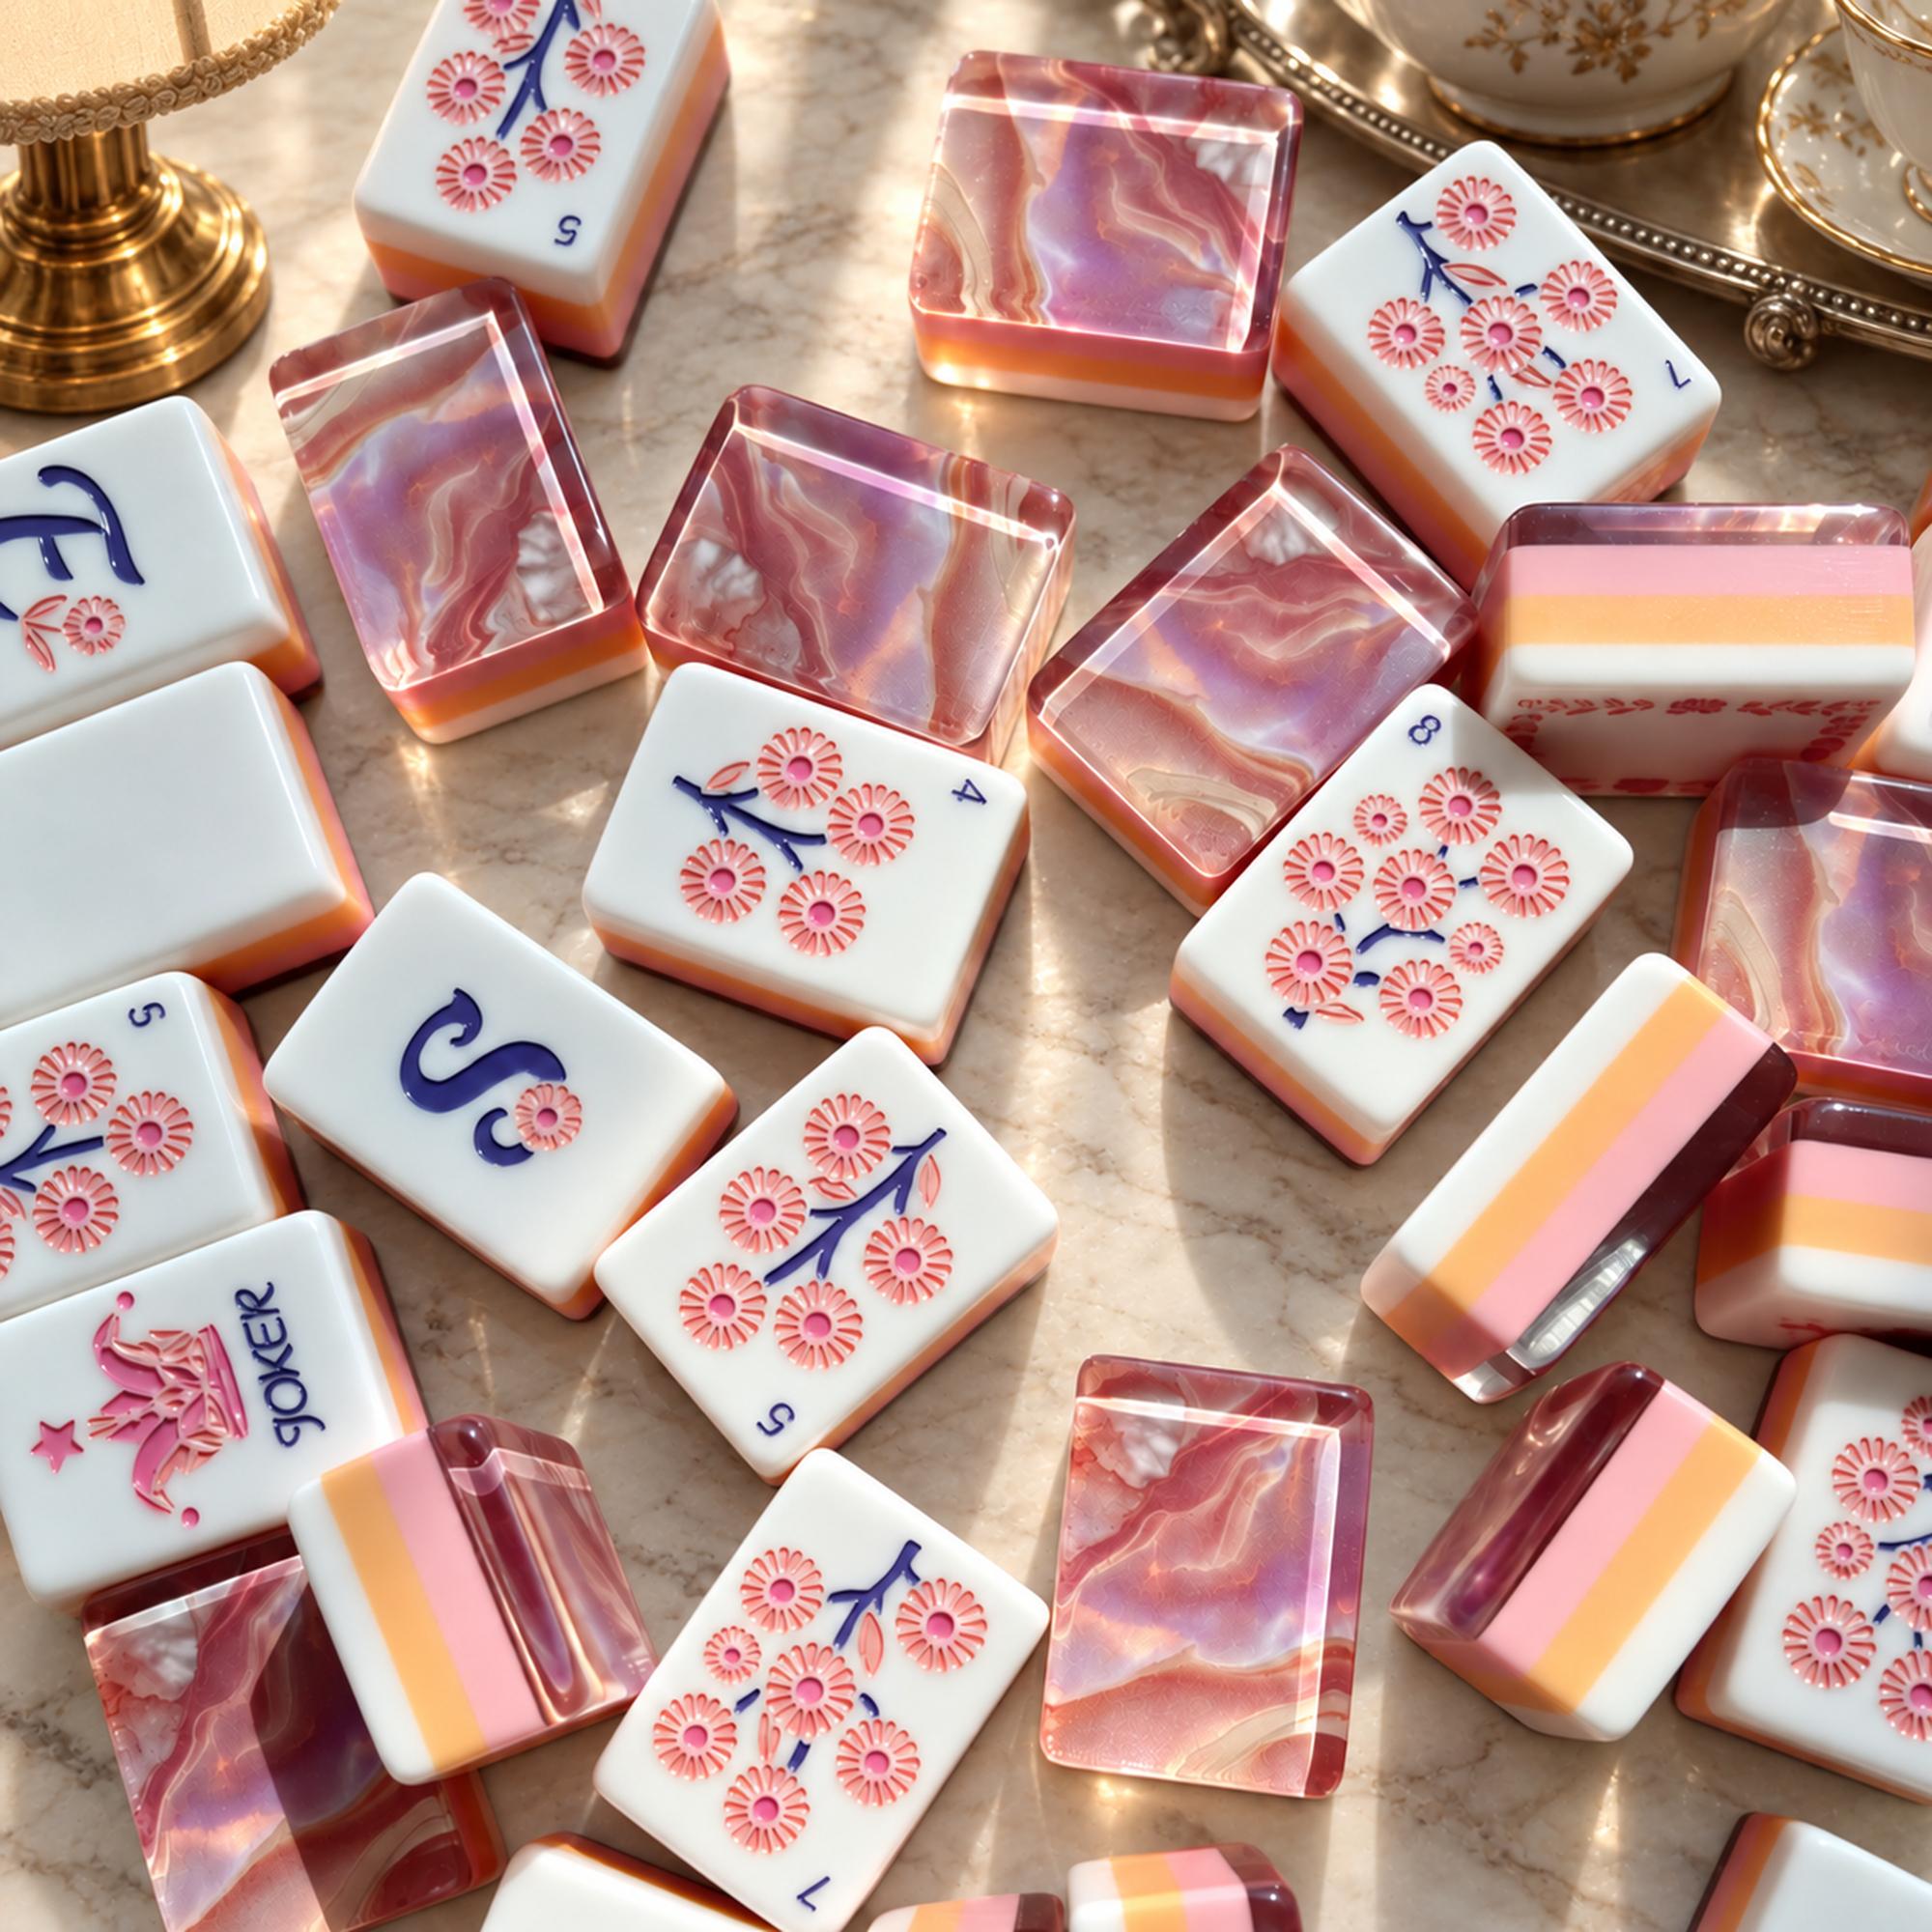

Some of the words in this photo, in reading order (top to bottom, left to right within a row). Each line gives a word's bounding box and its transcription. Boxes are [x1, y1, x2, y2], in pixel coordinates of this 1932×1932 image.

[554, 214, 582, 246] 5
[1665, 359, 1691, 388] 7
[1408, 715, 1441, 745] 8
[952, 779, 986, 805] 4
[128, 1002, 166, 1028] 5
[235, 1282, 326, 1448] JOKER
[756, 1403, 795, 1436] 5
[797, 1876, 830, 1911] 7
